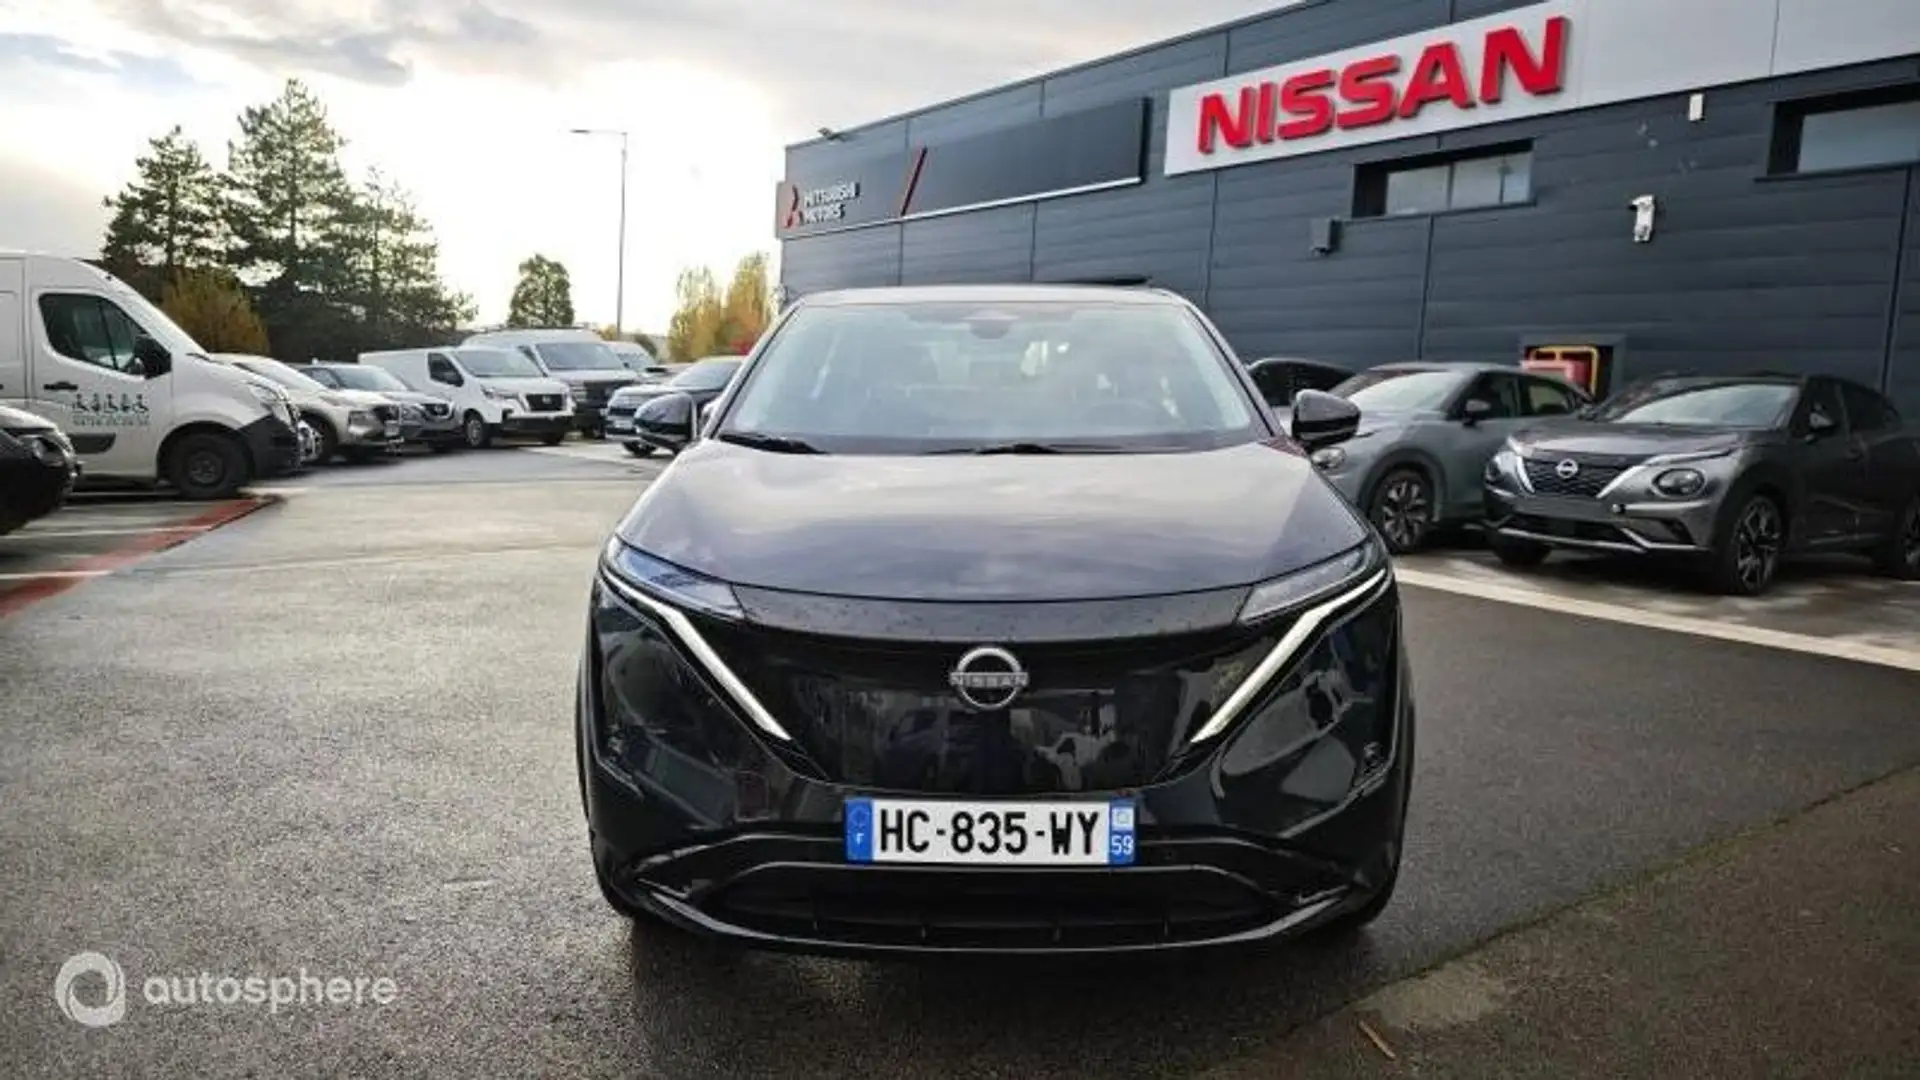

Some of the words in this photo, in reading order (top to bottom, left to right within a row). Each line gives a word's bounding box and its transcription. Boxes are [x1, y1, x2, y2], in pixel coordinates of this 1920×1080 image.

[1198, 15, 1567, 154] NISSAN
[950, 672, 1028, 688] NISSAN
[880, 808, 1099, 856] HC-835-WY
[1111, 834, 1134, 856] 59
